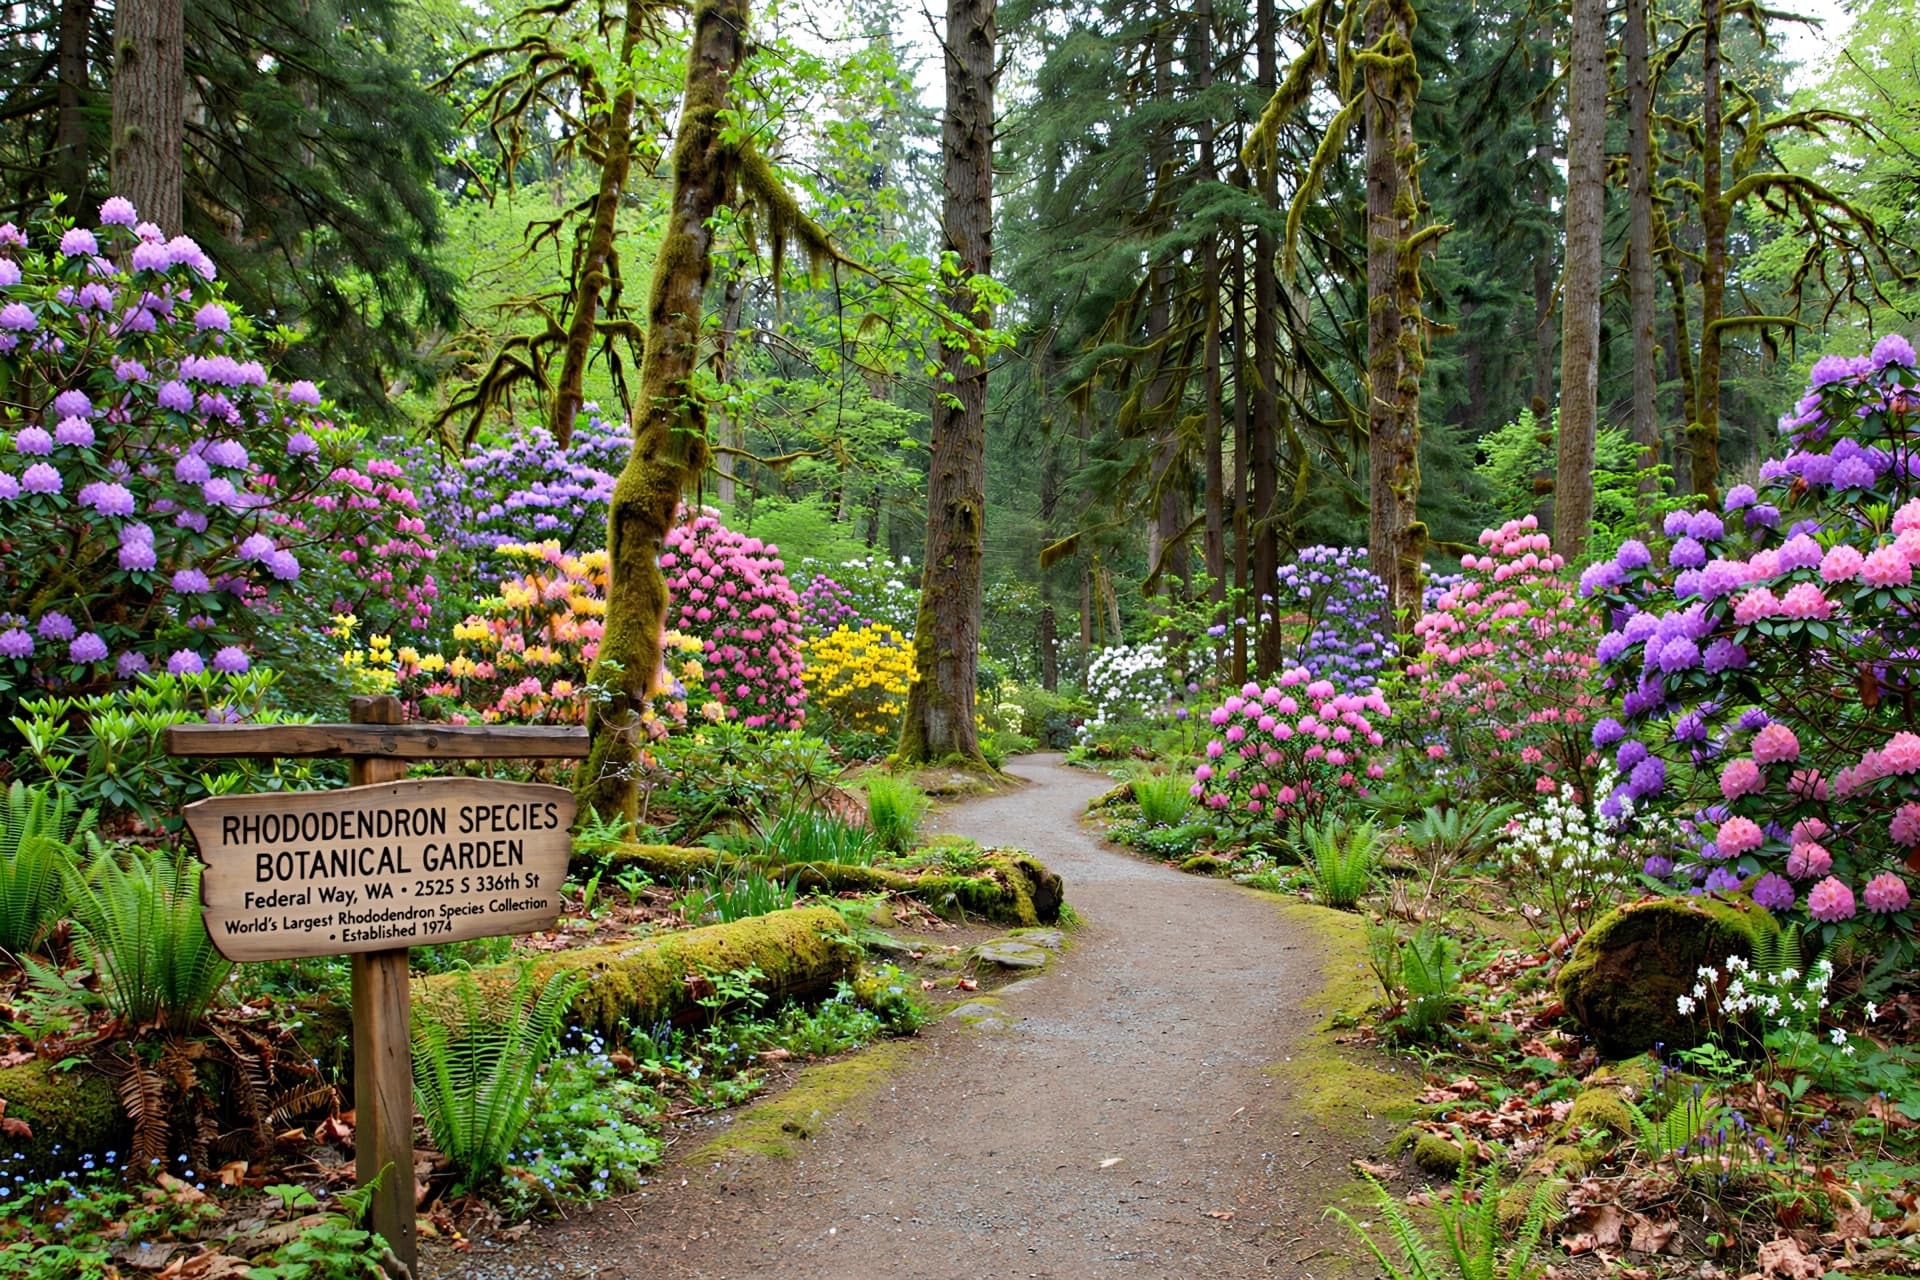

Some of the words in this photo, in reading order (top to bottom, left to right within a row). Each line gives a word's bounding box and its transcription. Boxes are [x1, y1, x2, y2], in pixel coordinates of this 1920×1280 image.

[222, 807, 446, 846] RHODODENDRON
[458, 802, 559, 834] SPECIES
[256, 845, 412, 883] BOTANICAL
[422, 839, 524, 872] GARDEN
[244, 886, 311, 910] Federal
[318, 886, 358, 908] Way,
[365, 882, 394, 900] WA
[414, 879, 455, 897] 2525
[460, 877, 470, 894] S
[476, 872, 520, 893] 336th
[524, 872, 540, 889] St
[225, 916, 278, 935] World's
[283, 914, 333, 933] Largest
[338, 907, 435, 926] Rhododendron
[439, 903, 485, 920] Species
[489, 897, 548, 914] Collection
[342, 922, 417, 943] Established
[422, 919, 453, 935] 1974
